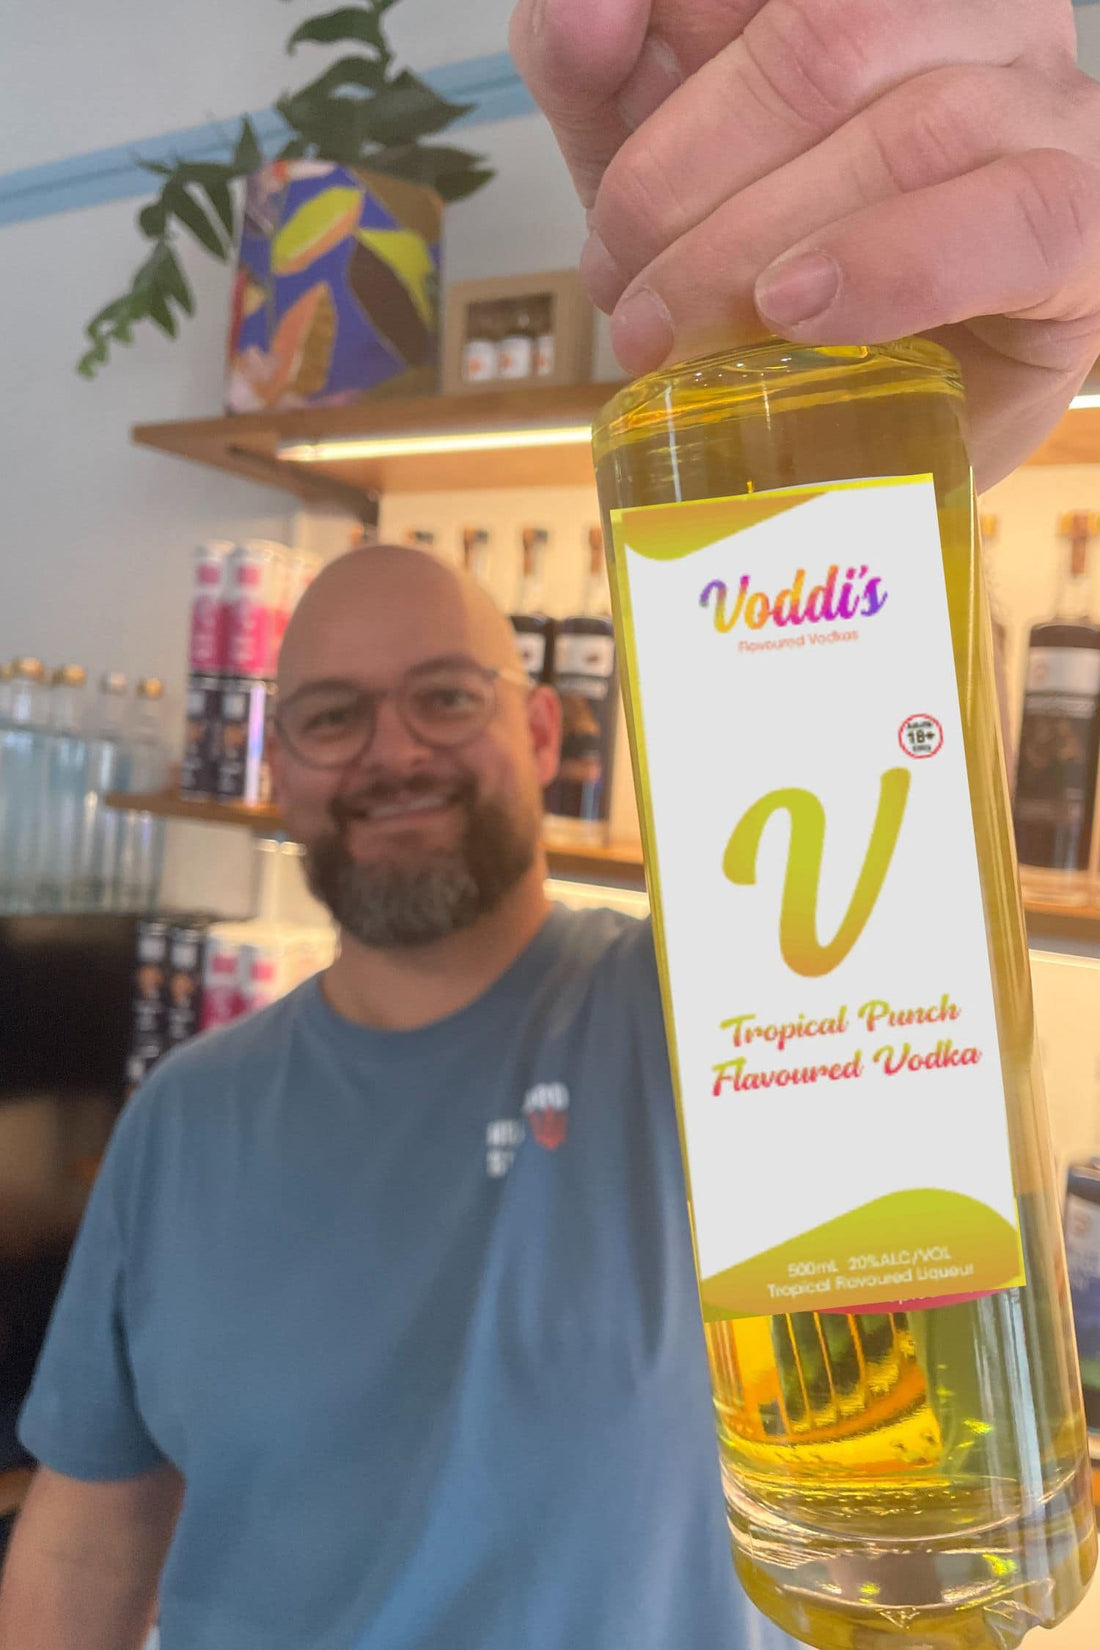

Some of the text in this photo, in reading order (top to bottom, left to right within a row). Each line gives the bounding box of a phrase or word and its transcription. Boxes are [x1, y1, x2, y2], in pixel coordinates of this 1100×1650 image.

[699, 564, 888, 634] Voddi's
[738, 630, 859, 652] Flavoured Vodkas
[907, 729, 935, 744] 18+
[722, 766, 911, 978] V
[719, 993, 961, 1050] Tropical Punch
[711, 1038, 983, 1097] Flavoured Vodka
[767, 1264, 974, 1299] Tropical Flavoured Liqueur
